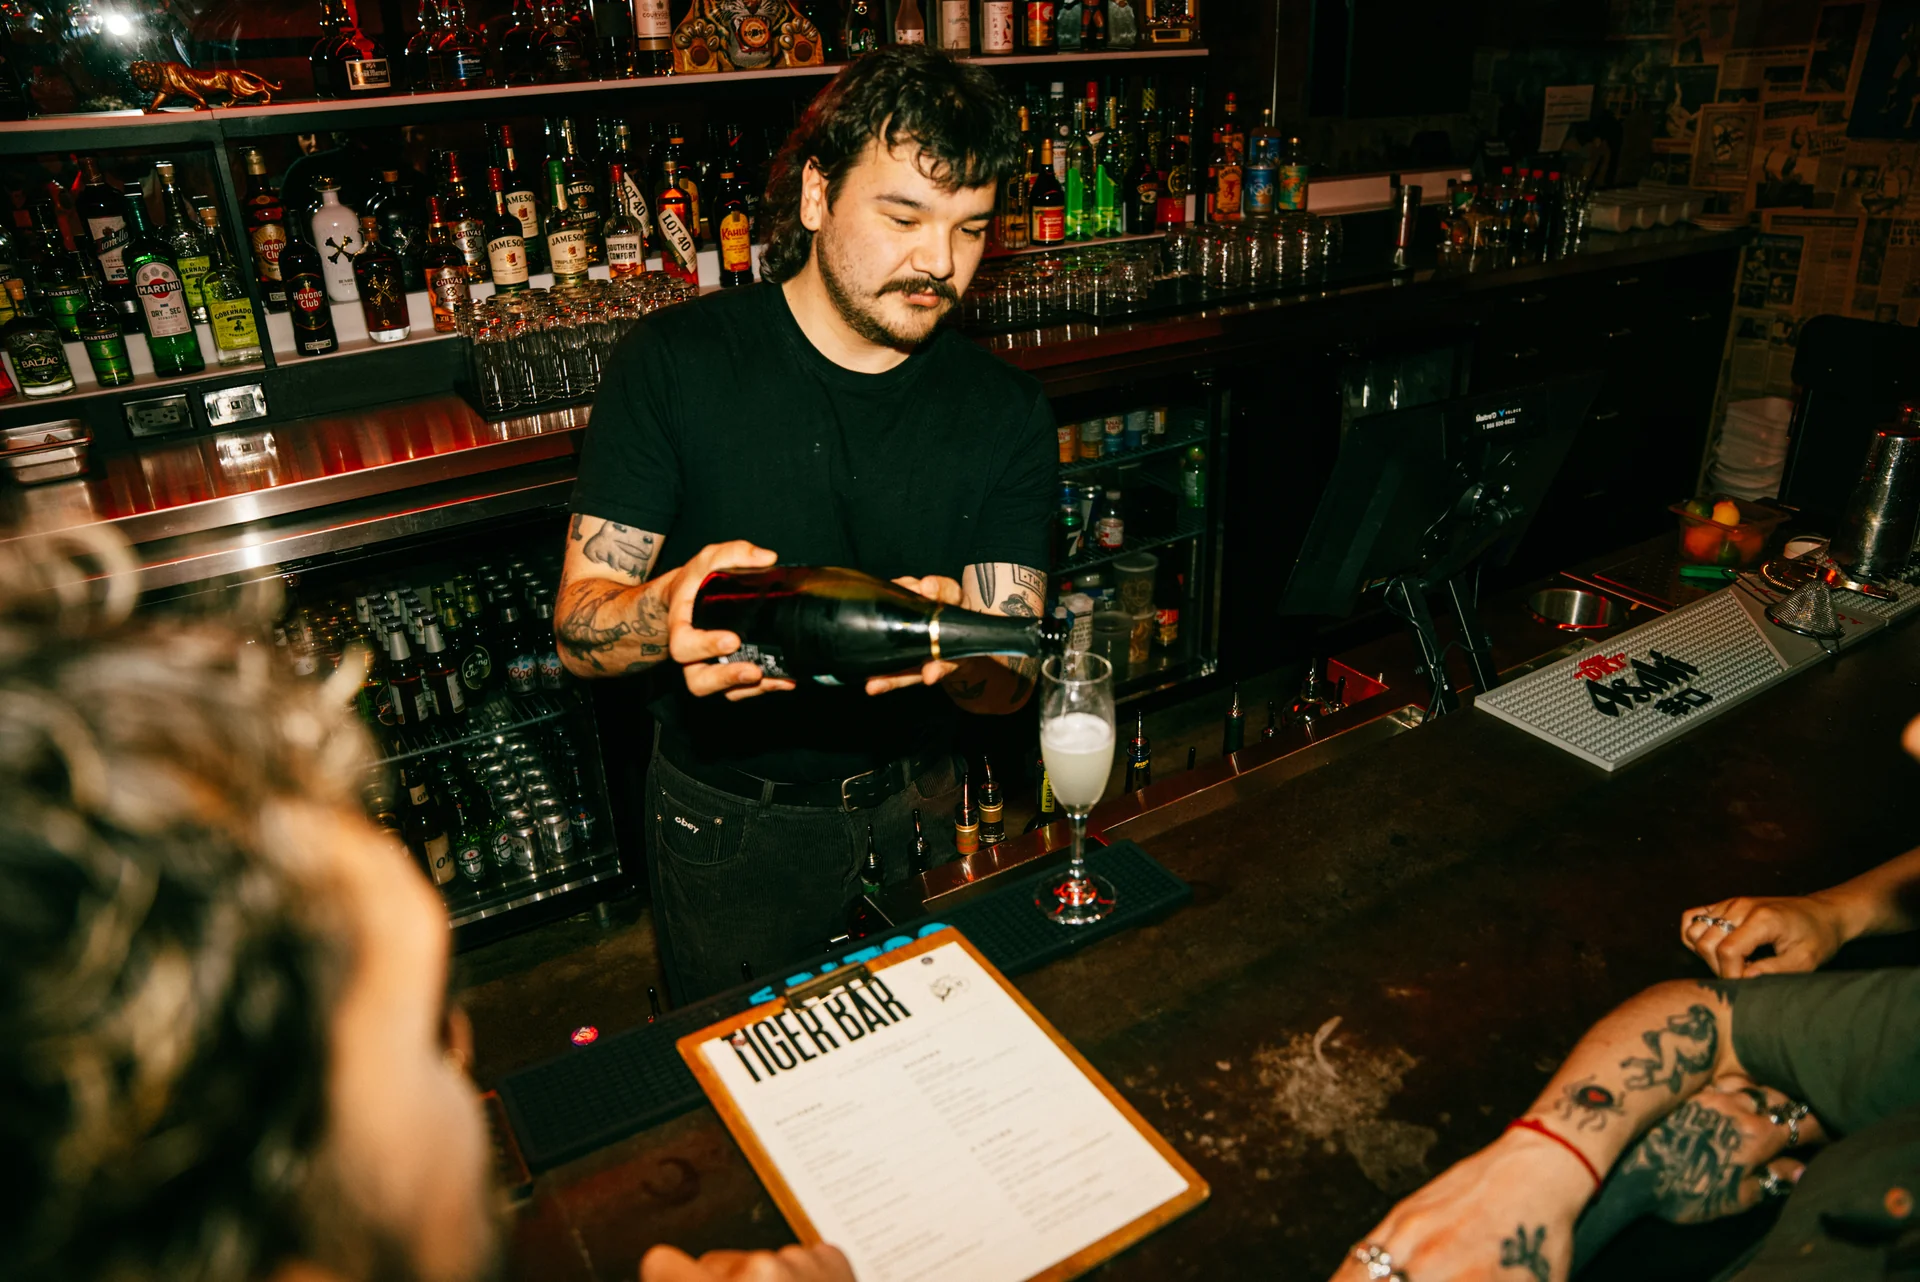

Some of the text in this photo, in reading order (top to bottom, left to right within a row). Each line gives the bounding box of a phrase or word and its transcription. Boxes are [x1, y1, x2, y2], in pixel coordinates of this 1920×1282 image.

[567, 185, 595, 196] AMESO
[506, 195, 534, 205] AMESO
[632, 199, 646, 216] 40
[456, 228, 481, 238] CHIVAS
[662, 213, 691, 251] LOT 40
[607, 243, 637, 252] SOUTHERN
[266, 249, 281, 260] Clu
[610, 251, 636, 260] COMFORT
[436, 277, 462, 287] CHIVAS
[48, 288, 81, 297] CHARTREUS
[138, 281, 181, 296] MARTINI
[293, 289, 322, 301] Havana
[300, 299, 319, 309] Club
[151, 309, 164, 318] DRY
[169, 306, 182, 315] SEC
[214, 308, 253, 320] GOBERNADO
[22, 356, 59, 369] BALZAC
[509, 666, 535, 680] Coo
[540, 663, 561, 677] Coo
[674, 816, 700, 834] obey
[720, 1006, 840, 1083] TIGER
[822, 976, 912, 1042] BAR
